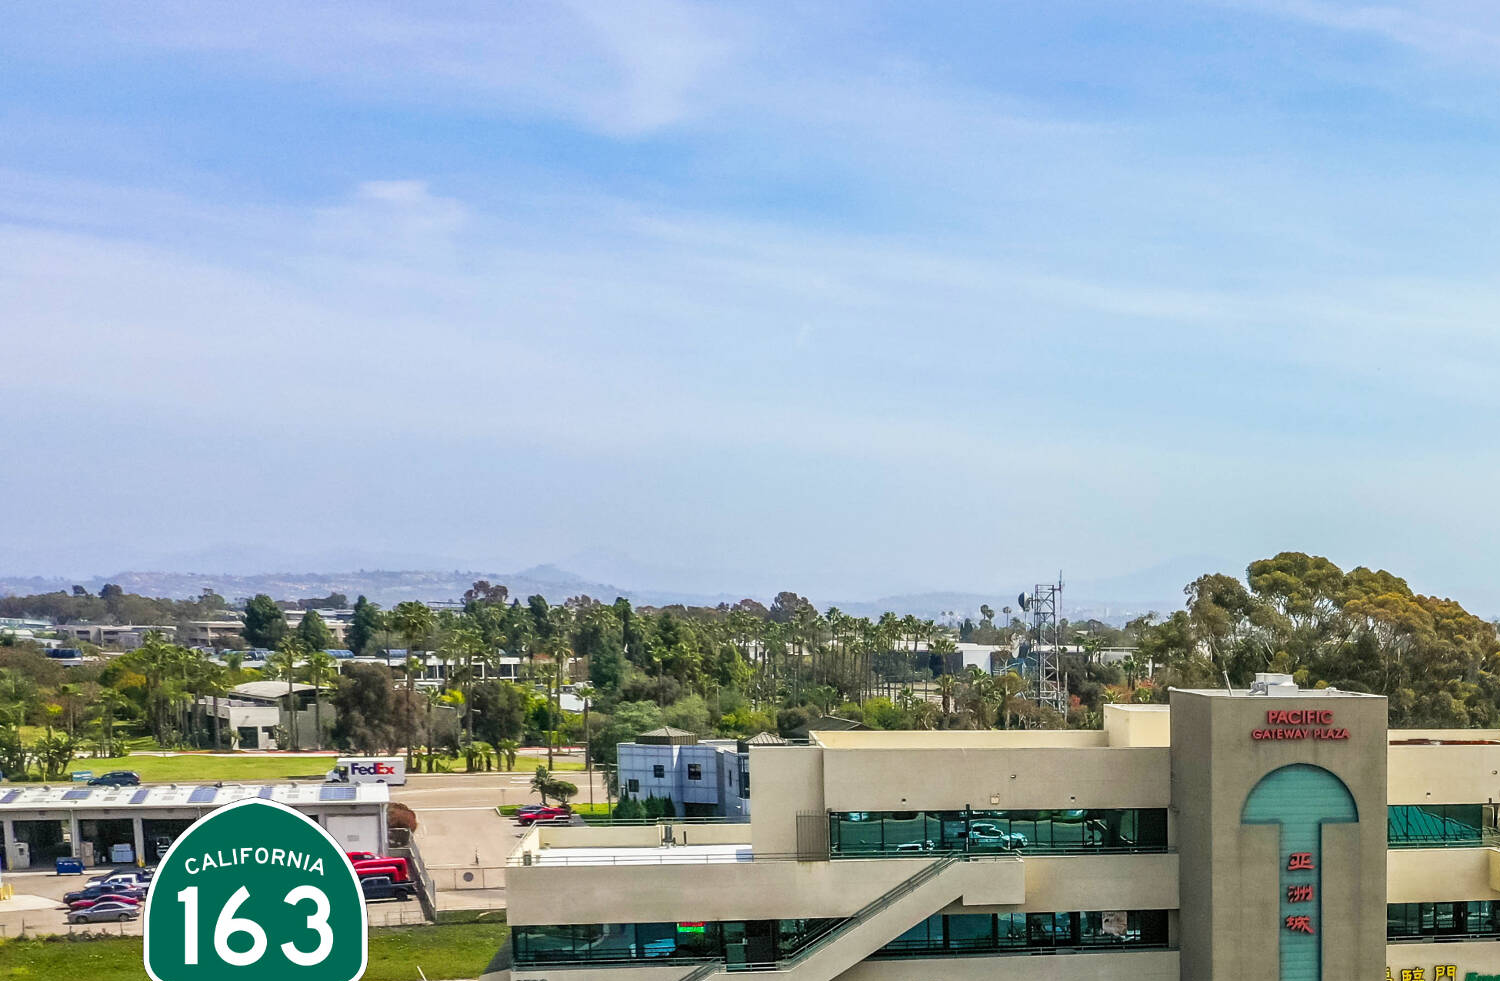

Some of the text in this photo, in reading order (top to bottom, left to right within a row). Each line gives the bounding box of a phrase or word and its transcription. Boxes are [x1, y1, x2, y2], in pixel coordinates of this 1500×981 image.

[1267, 710, 1334, 725] PACIFIC
[1252, 727, 1351, 740] GATEWAY PLAZA
[350, 762, 395, 775] FedEx
